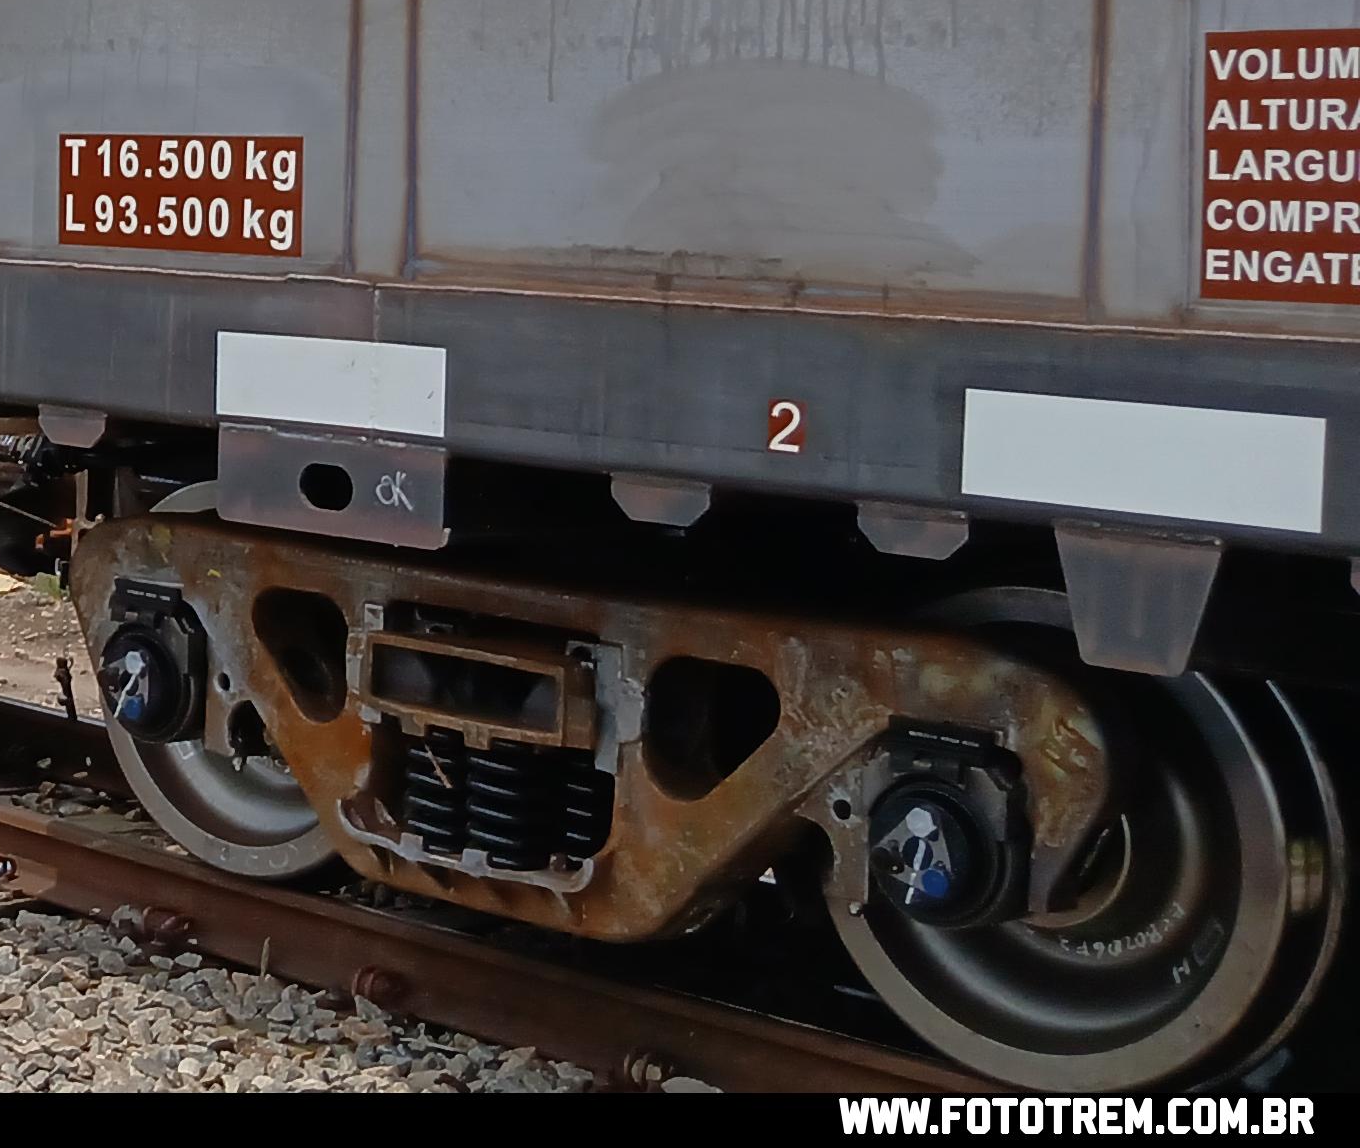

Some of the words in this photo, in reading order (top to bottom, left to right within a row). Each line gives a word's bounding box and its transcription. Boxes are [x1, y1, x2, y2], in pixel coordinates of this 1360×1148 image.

[65, 139, 86, 177] T
[97, 139, 231, 180] 16.500
[245, 141, 297, 192] kg
[1208, 150, 1360, 182] LARGU
[65, 194, 86, 232] L
[94, 195, 229, 238] 93.500
[242, 199, 294, 251] kg
[768, 402, 801, 452] 2
